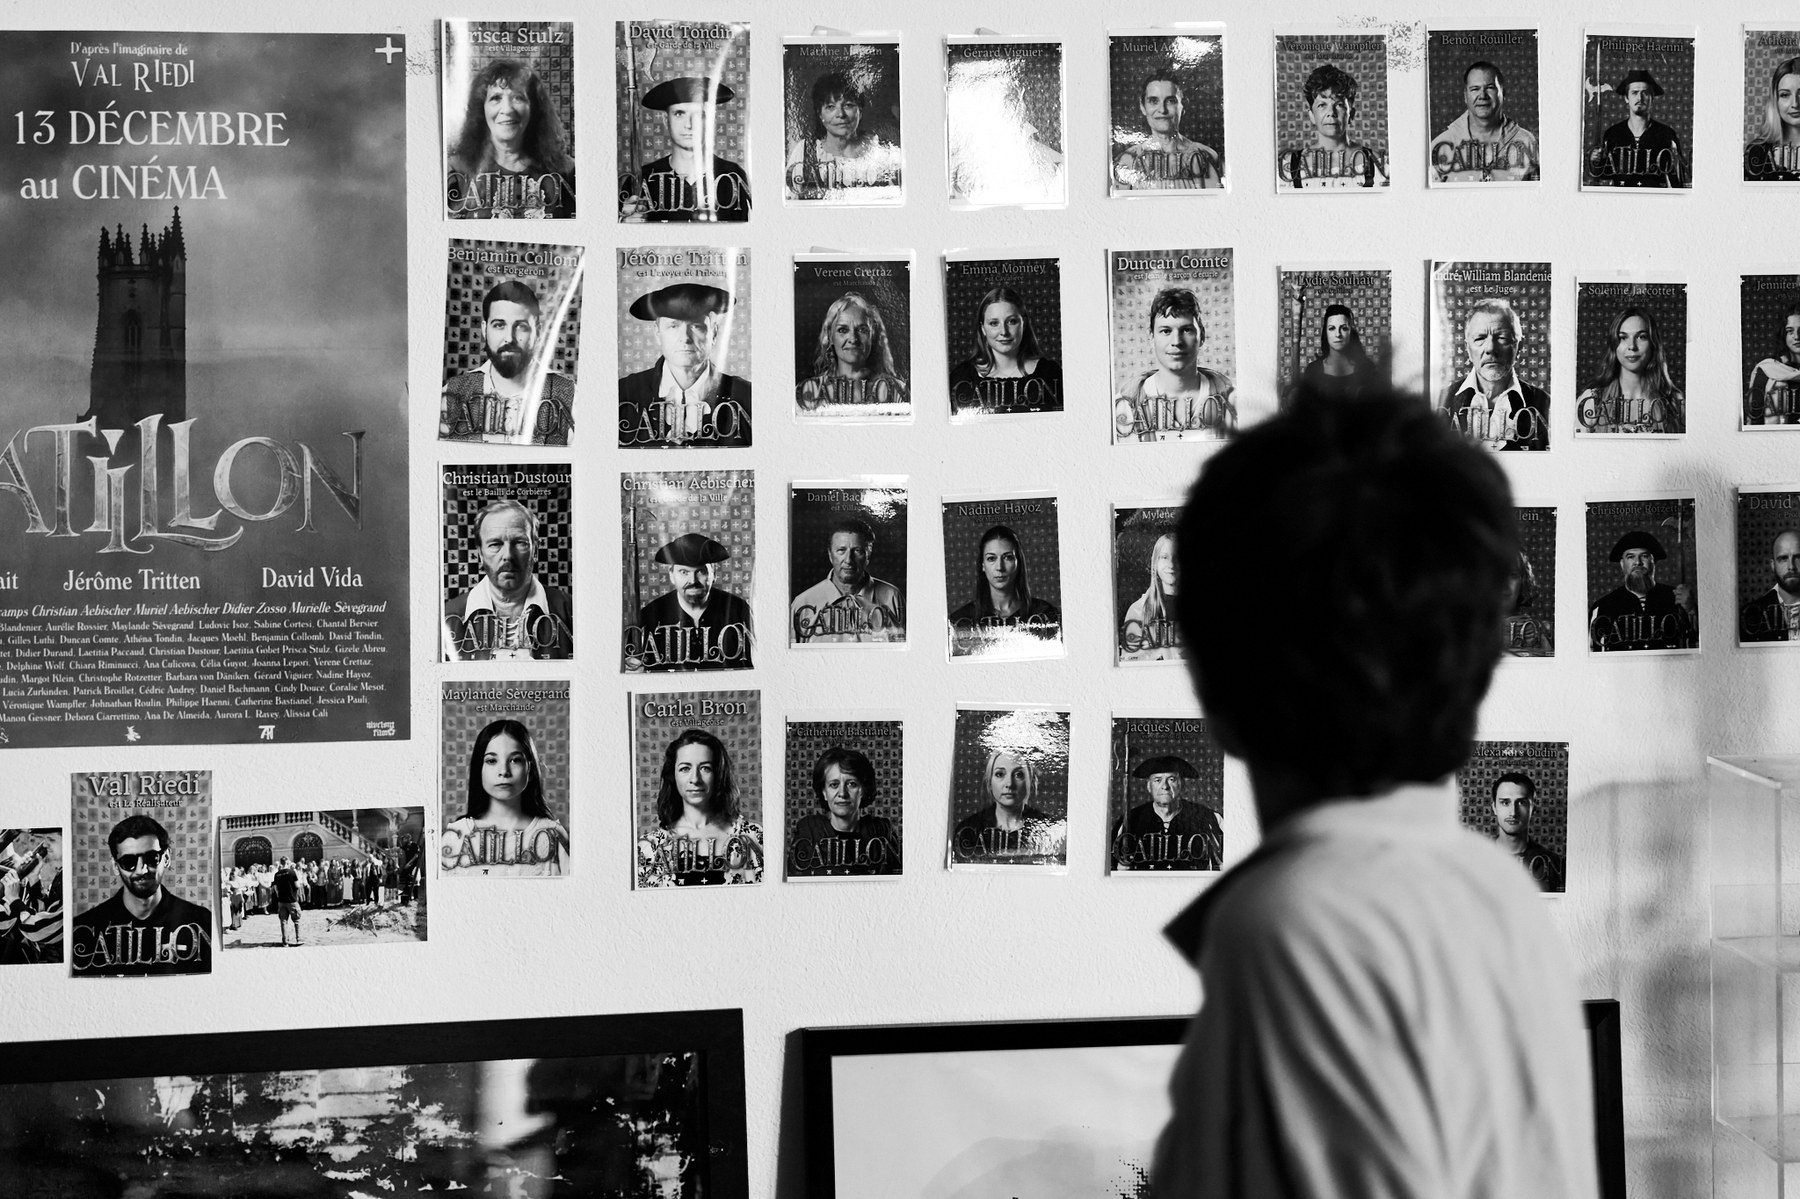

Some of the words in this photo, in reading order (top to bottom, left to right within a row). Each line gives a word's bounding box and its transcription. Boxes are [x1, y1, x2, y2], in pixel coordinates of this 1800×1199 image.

[468, 27, 511, 43] risca
[517, 27, 564, 43] Stulz
[630, 25, 675, 39] David
[680, 24, 737, 39] Tondin
[1441, 33, 1476, 45] Benoît
[1480, 33, 1523, 44] Rouiller
[70, 42, 109, 56] D'après
[112, 43, 173, 56] l'imaginaire
[174, 44, 188, 55] de
[963, 47, 1001, 58] Gérard
[1004, 47, 1043, 60] Viguier
[1123, 42, 1158, 53] Muriel
[1601, 40, 1643, 53] Philippe
[1647, 41, 1683, 51] Haenni
[71, 58, 122, 87] VAL
[133, 59, 195, 92] RIEDI
[14, 110, 55, 145] 13
[69, 100, 290, 146] DÉCEMBRE
[20, 176, 59, 199] au
[72, 155, 227, 200] CINÉMA
[448, 247, 519, 264] Benjamin
[524, 249, 578, 267] Collom
[622, 249, 684, 270] Jérôme
[1117, 257, 1176, 271] Duncan
[1180, 255, 1229, 269] Comte
[503, 266, 545, 276] Forgeron
[814, 267, 852, 278] Verene
[854, 267, 892, 277] Crettaz
[962, 263, 998, 275] Emma
[1002, 262, 1046, 275] Monney
[1504, 269, 1551, 281] Blandenie
[1331, 273, 1374, 286] Souhait
[1470, 285, 1483, 293] est
[618, 400, 751, 445] CATILLON
[0, 413, 366, 553] ATILLON
[443, 471, 510, 485] Christian
[514, 471, 572, 484] Dustour
[622, 477, 685, 491] Christian
[484, 488, 504, 496] Bailli
[516, 487, 552, 496] Corbières
[807, 491, 839, 502] Daniel
[1749, 495, 1792, 509] David
[958, 503, 1000, 517] Nadine
[1004, 502, 1041, 516] Hayoz
[1516, 509, 1540, 521] lein
[63, 569, 133, 591] Jérôme
[138, 568, 201, 590] Tritten
[262, 567, 314, 588] David
[320, 566, 364, 587] Vida
[32, 604, 78, 617] Christian
[80, 603, 132, 616] Aebischer
[133, 603, 169, 615] Muriel
[169, 602, 221, 615] Aebischer
[222, 602, 255, 614] Didier
[256, 602, 287, 614] Zosso
[289, 601, 331, 613] Murielle
[333, 600, 387, 615] Sèvegrand
[60, 634, 91, 644] Duncan
[187, 633, 219, 644] Jacques
[251, 632, 289, 643] Benjamin
[329, 631, 352, 641] David
[444, 612, 574, 652] CATILLON
[624, 621, 757, 666] CATILLON
[15, 648, 41, 658] Didier
[149, 646, 186, 656] Christian
[282, 644, 307, 654] Prisca
[441, 687, 503, 703] Maylande
[506, 687, 570, 703] Sèvegrand
[475, 704, 488, 712] est
[490, 703, 535, 711] Marchande
[643, 699, 695, 718] Carla
[701, 699, 748, 716] Bron
[1126, 721, 1170, 735] Jacques
[88, 774, 131, 796] Val
[139, 773, 200, 796] Riedi
[72, 921, 212, 971] CATILLON
